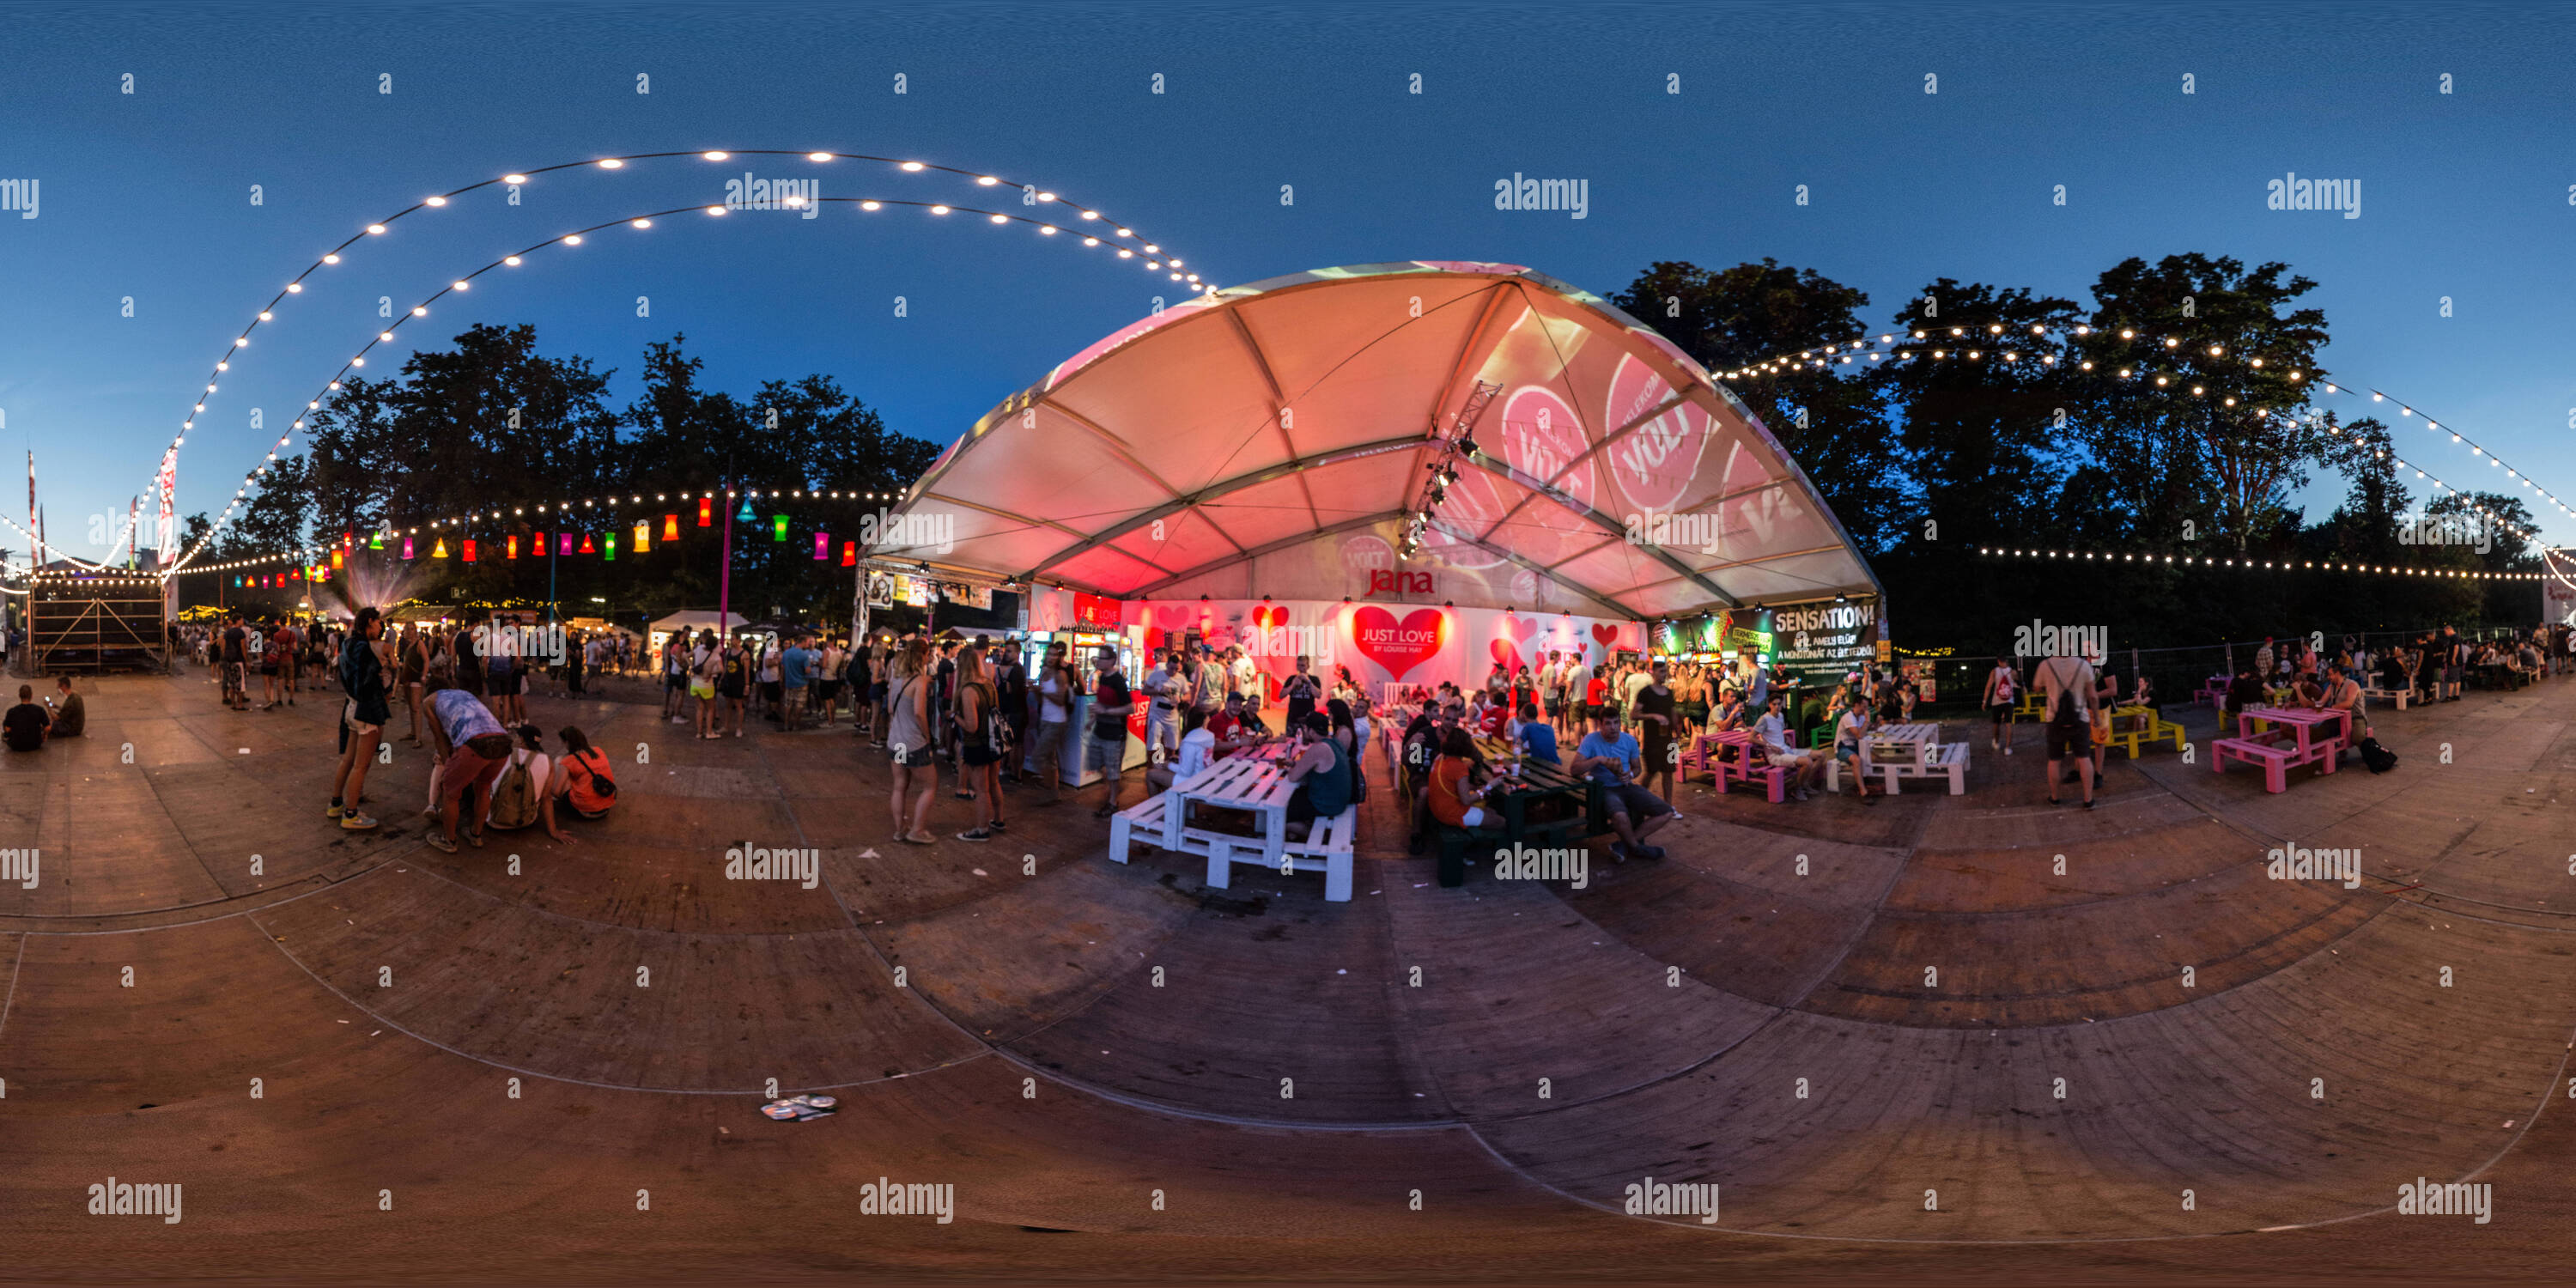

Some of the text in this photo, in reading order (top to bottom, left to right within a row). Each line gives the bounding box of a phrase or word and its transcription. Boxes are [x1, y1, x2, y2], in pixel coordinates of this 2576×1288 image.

[1621, 387, 1691, 486] VOLT
[1079, 605, 1119, 621] JUST LOVE
[1776, 605, 1875, 632] SENSATION!
[1363, 629, 1434, 643] JUST LOVE
[1777, 650, 1783, 659] A
[1826, 649, 1837, 658] AZ
